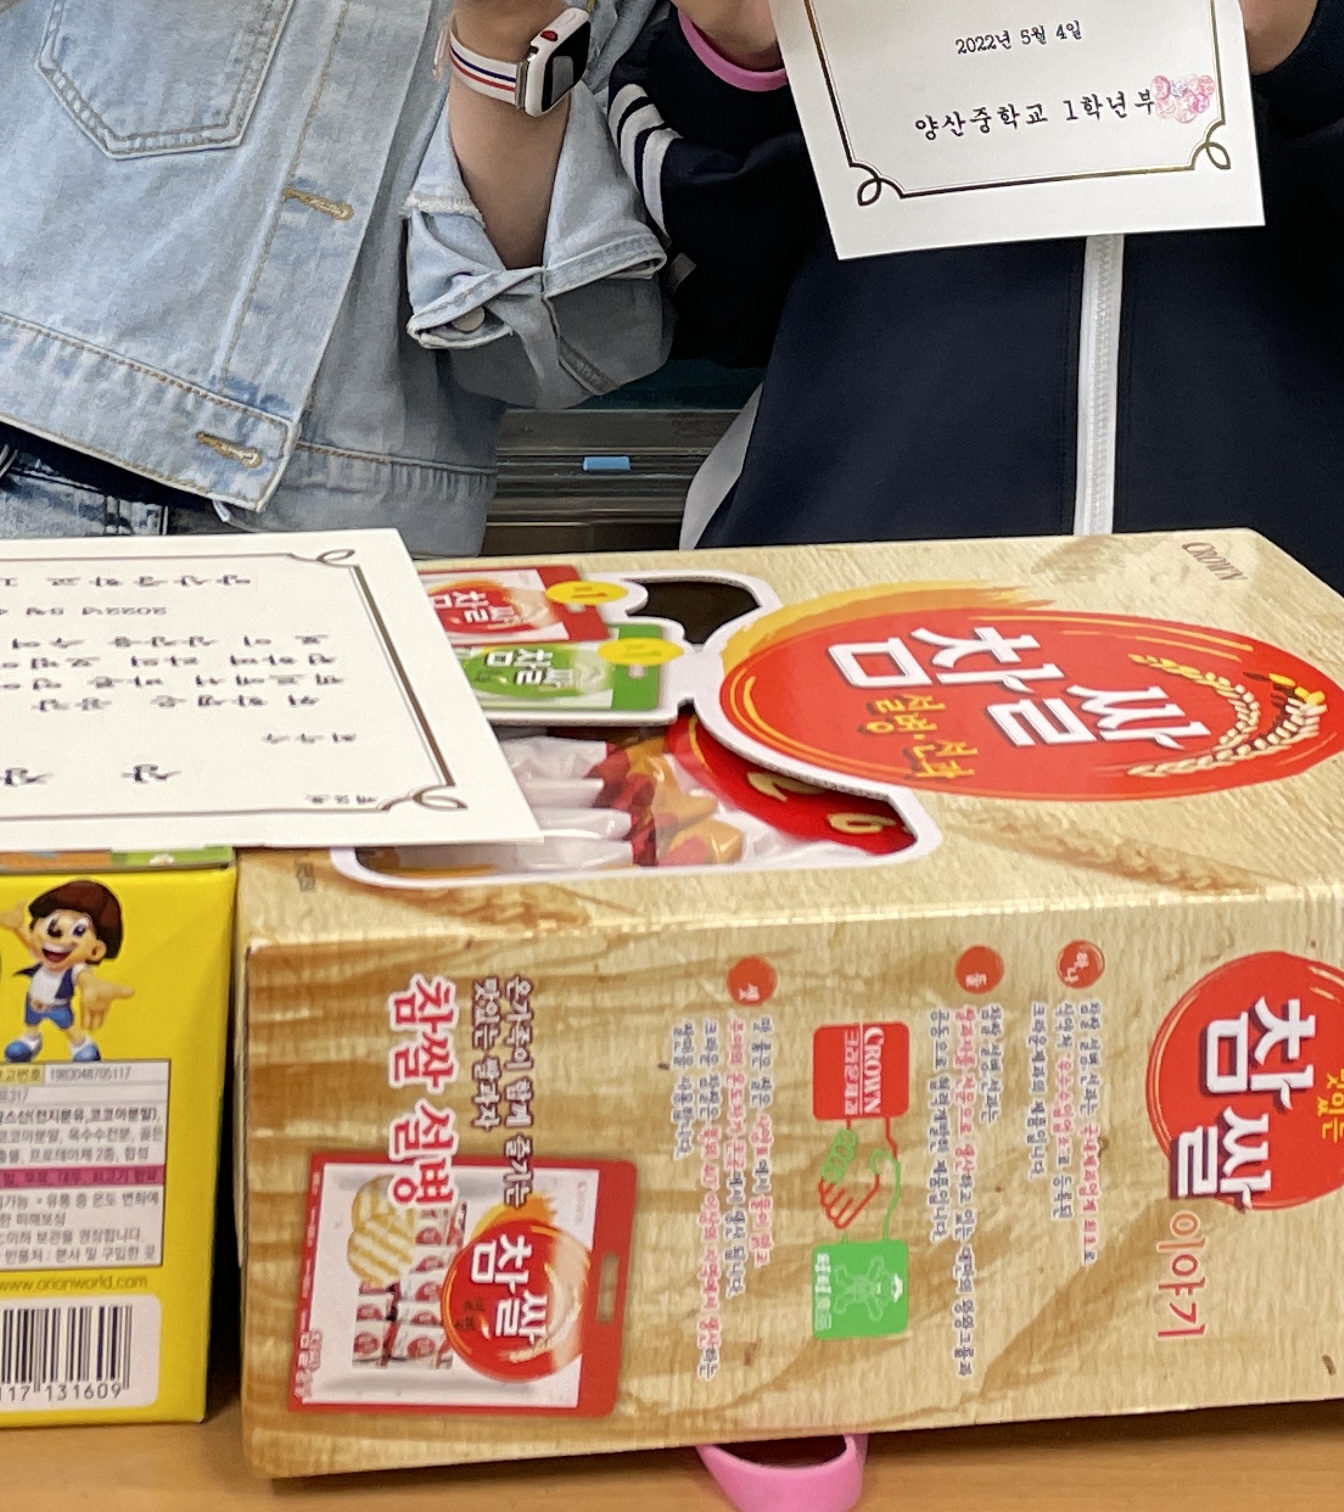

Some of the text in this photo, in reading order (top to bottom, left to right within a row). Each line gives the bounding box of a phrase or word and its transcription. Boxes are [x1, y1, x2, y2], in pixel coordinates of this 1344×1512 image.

[955, 20, 1082, 55] 2022년 5월 4일
[915, 102, 1048, 141] 양산중학교
[1182, 542, 1248, 582] CROWN
[829, 627, 1211, 751] 참쌀
[390, 976, 458, 1207] 참쌀 설병
[471, 976, 502, 1130] 맛있는 쌀과자
[503, 974, 534, 1208] 온가족이 함께 즐기는
[862, 1026, 886, 1114] CROWN
[1176, 997, 1316, 1212] 참쌀
[471, 1234, 550, 1345] 참쌀
[1158, 1210, 1206, 1338] 이야기
[45, 1382, 122, 1402] 131609
